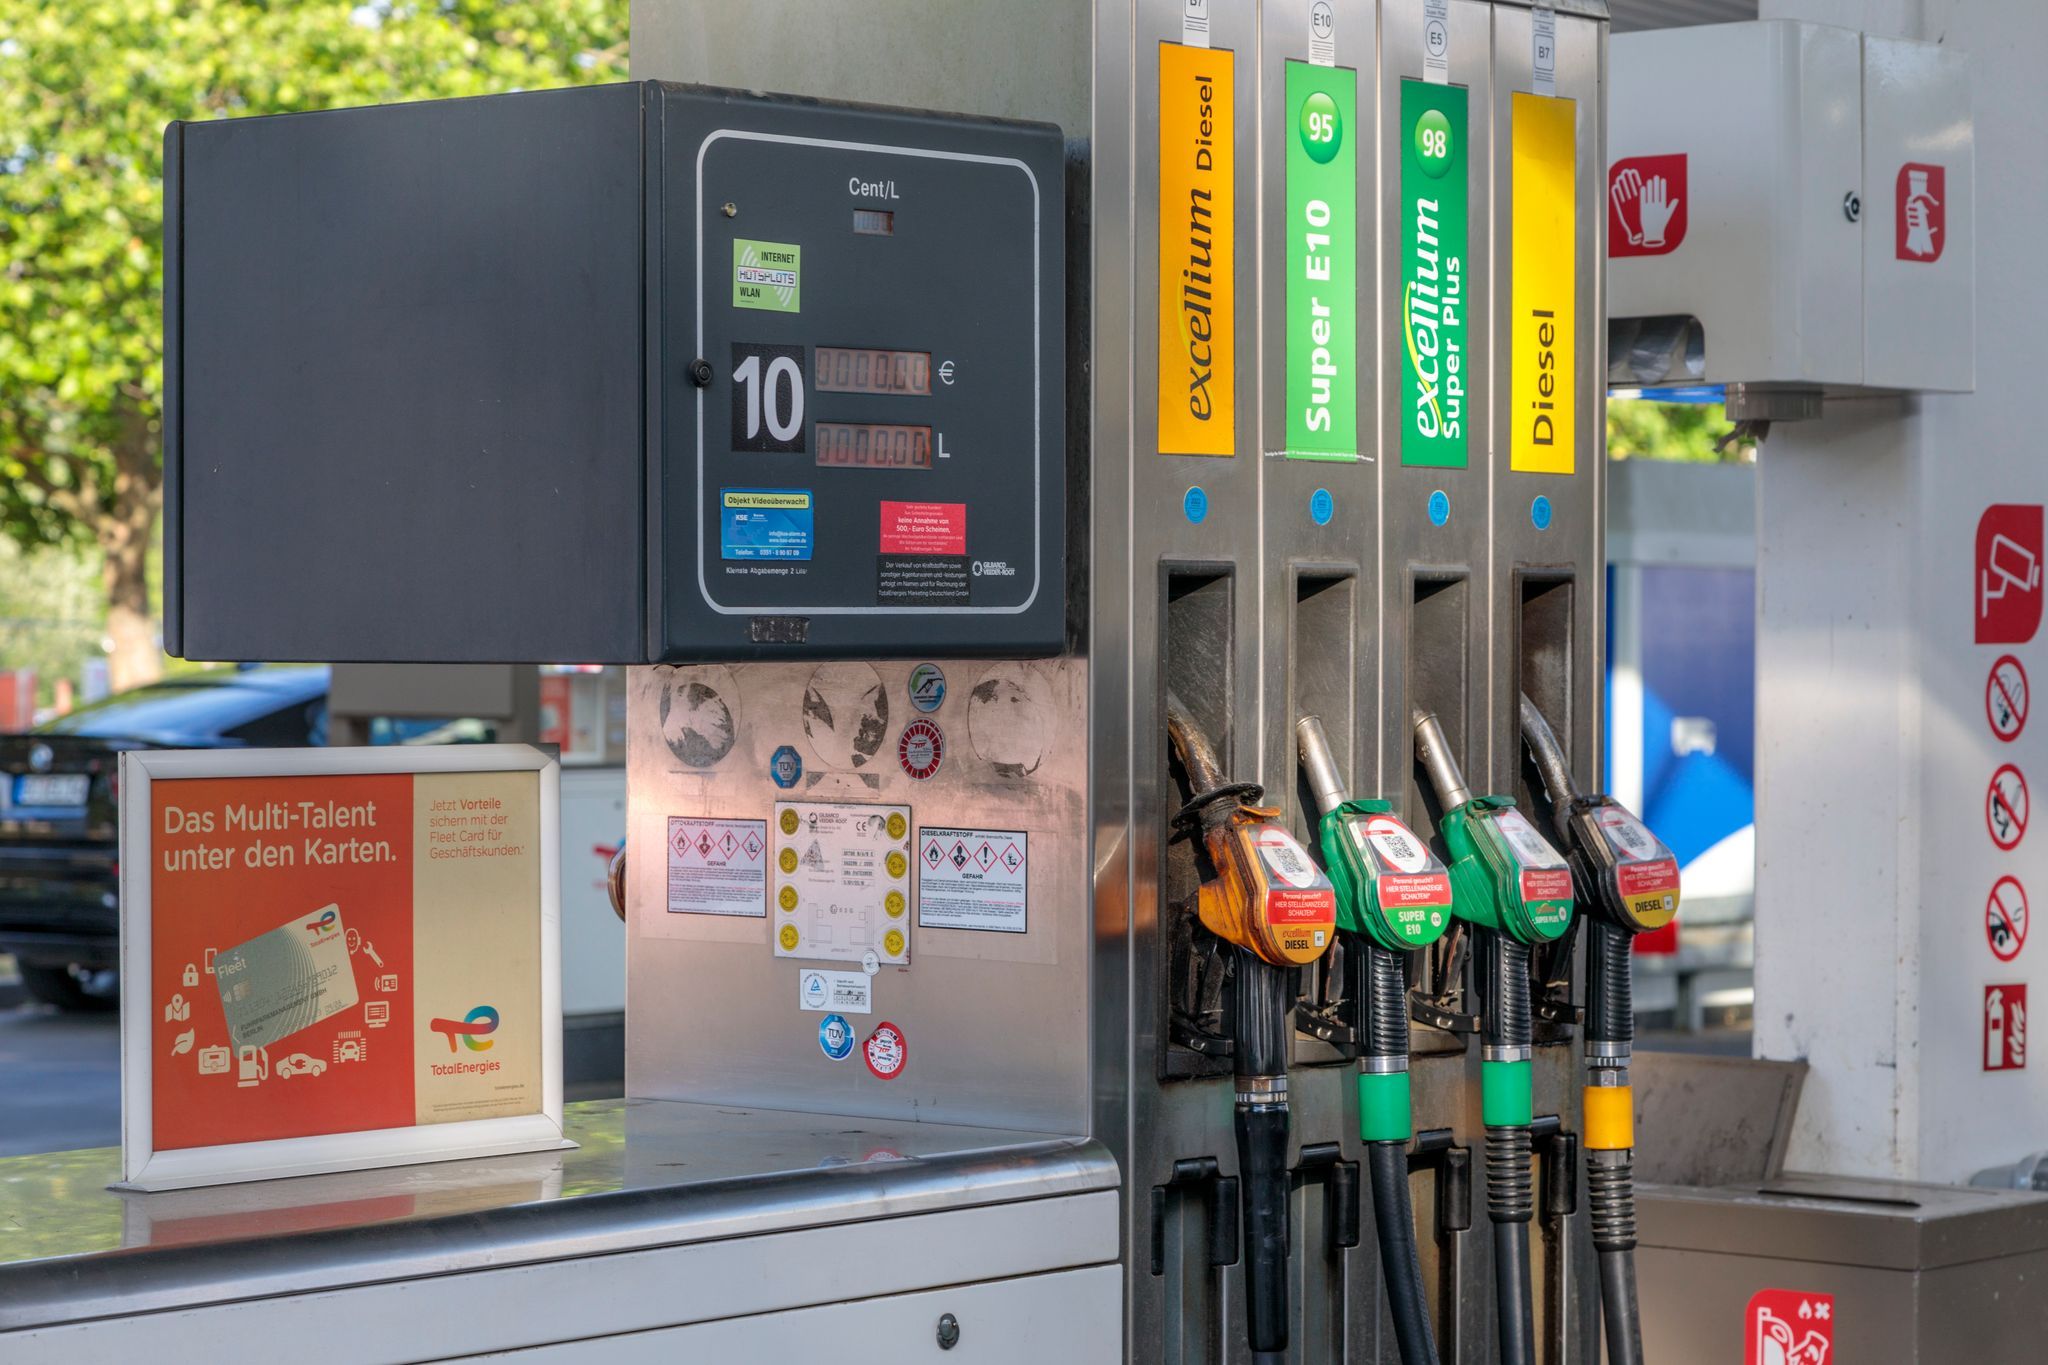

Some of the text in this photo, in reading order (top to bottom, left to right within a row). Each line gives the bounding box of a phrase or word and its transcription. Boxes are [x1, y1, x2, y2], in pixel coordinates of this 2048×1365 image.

[1313, 13, 1331, 28] E10
[1430, 32, 1443, 45] E5
[1538, 46, 1550, 59] B7
[1308, 112, 1333, 143] 95
[1422, 128, 1446, 159] 98
[849, 177, 900, 200] Cent/L
[1183, 75, 1213, 422] excellium Diesel
[761, 251, 795, 264] INTERNET
[740, 286, 760, 298] WLAN
[1306, 200, 1337, 432] Super E10
[1410, 198, 1439, 438] excellium
[1442, 256, 1465, 438] Super Plus
[1532, 309, 1555, 446] Diesel
[732, 356, 805, 442] 10
[938, 433, 951, 458] L
[728, 496, 806, 505] Objekt Videoüberwacht
[898, 516, 912, 524] keine
[913, 517, 938, 525] Annahme
[896, 525, 951, 534] 500,- Euro Scheinen,
[750, 567, 788, 575] Abgabemenge
[430, 797, 501, 811] Jetzt Vorteile
[164, 800, 376, 834] Das Multi-Talent
[430, 814, 508, 827] sichern mit der
[429, 829, 503, 843] Fleet Card für
[921, 830, 973, 838] DIESELKRAFTSTOFF
[163, 838, 397, 872] unter den Karten.
[1635, 899, 1662, 913] DIESEL
[1398, 910, 1426, 922] SUPER
[1406, 924, 1421, 935] E10
[1285, 939, 1309, 950] DIESEL
[218, 958, 247, 978] Fleet
[431, 1060, 500, 1075] TotalEnergies
